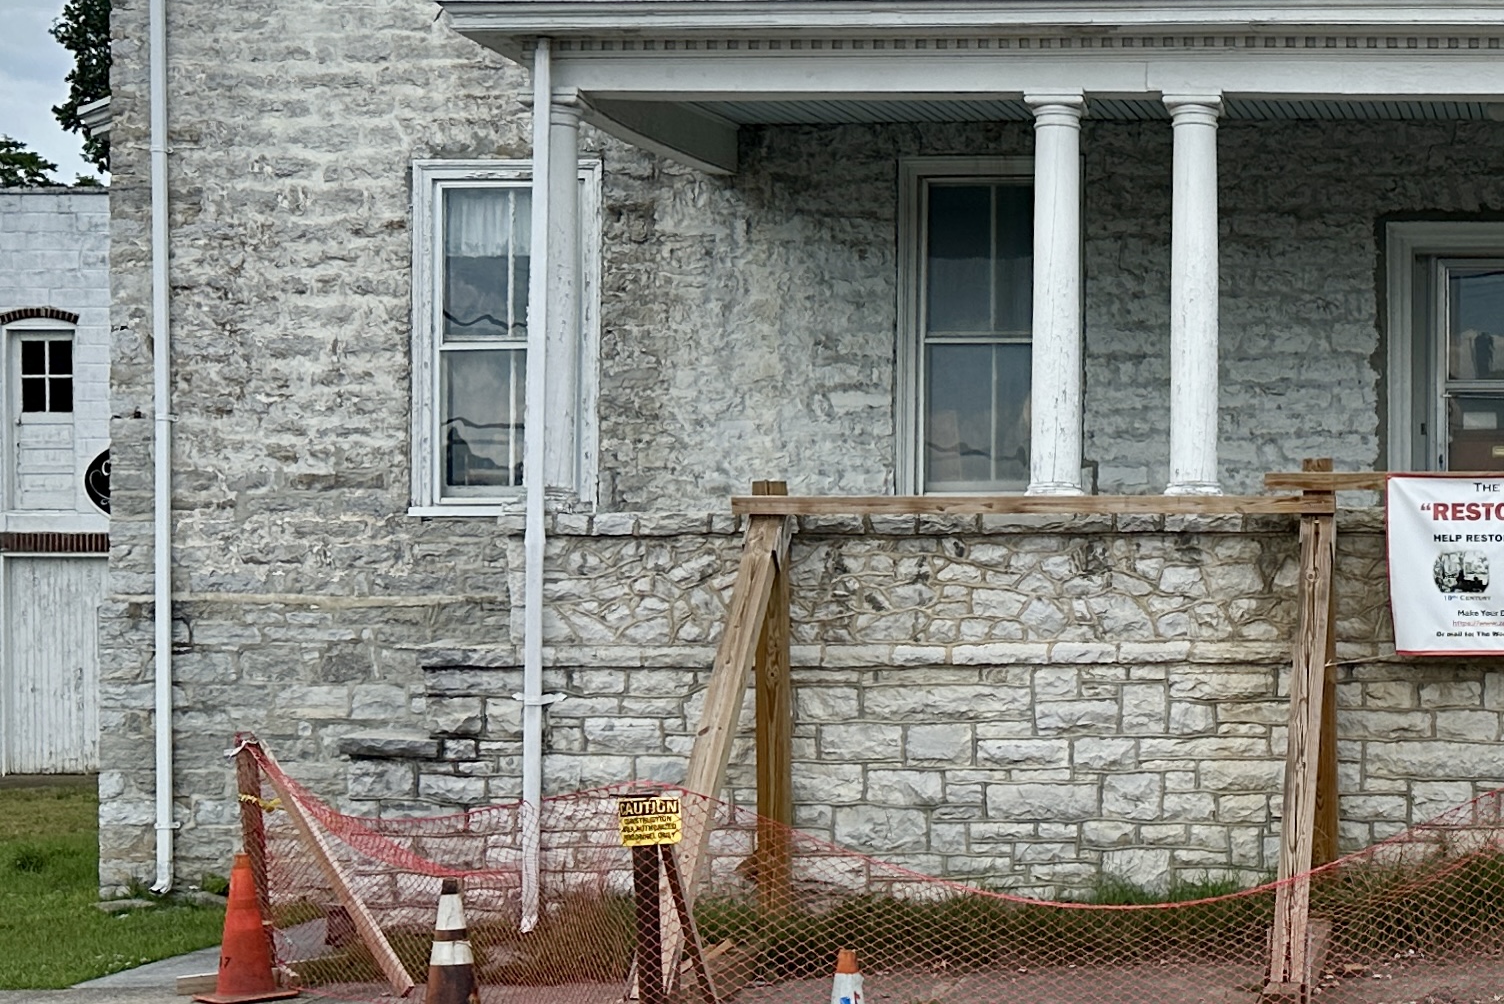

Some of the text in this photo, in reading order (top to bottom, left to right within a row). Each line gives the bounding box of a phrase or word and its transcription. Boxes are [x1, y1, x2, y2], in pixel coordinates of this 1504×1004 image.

[1473, 482, 1500, 492] THE
[1433, 534, 1462, 543] HELP
[619, 800, 678, 815] CAUTION
